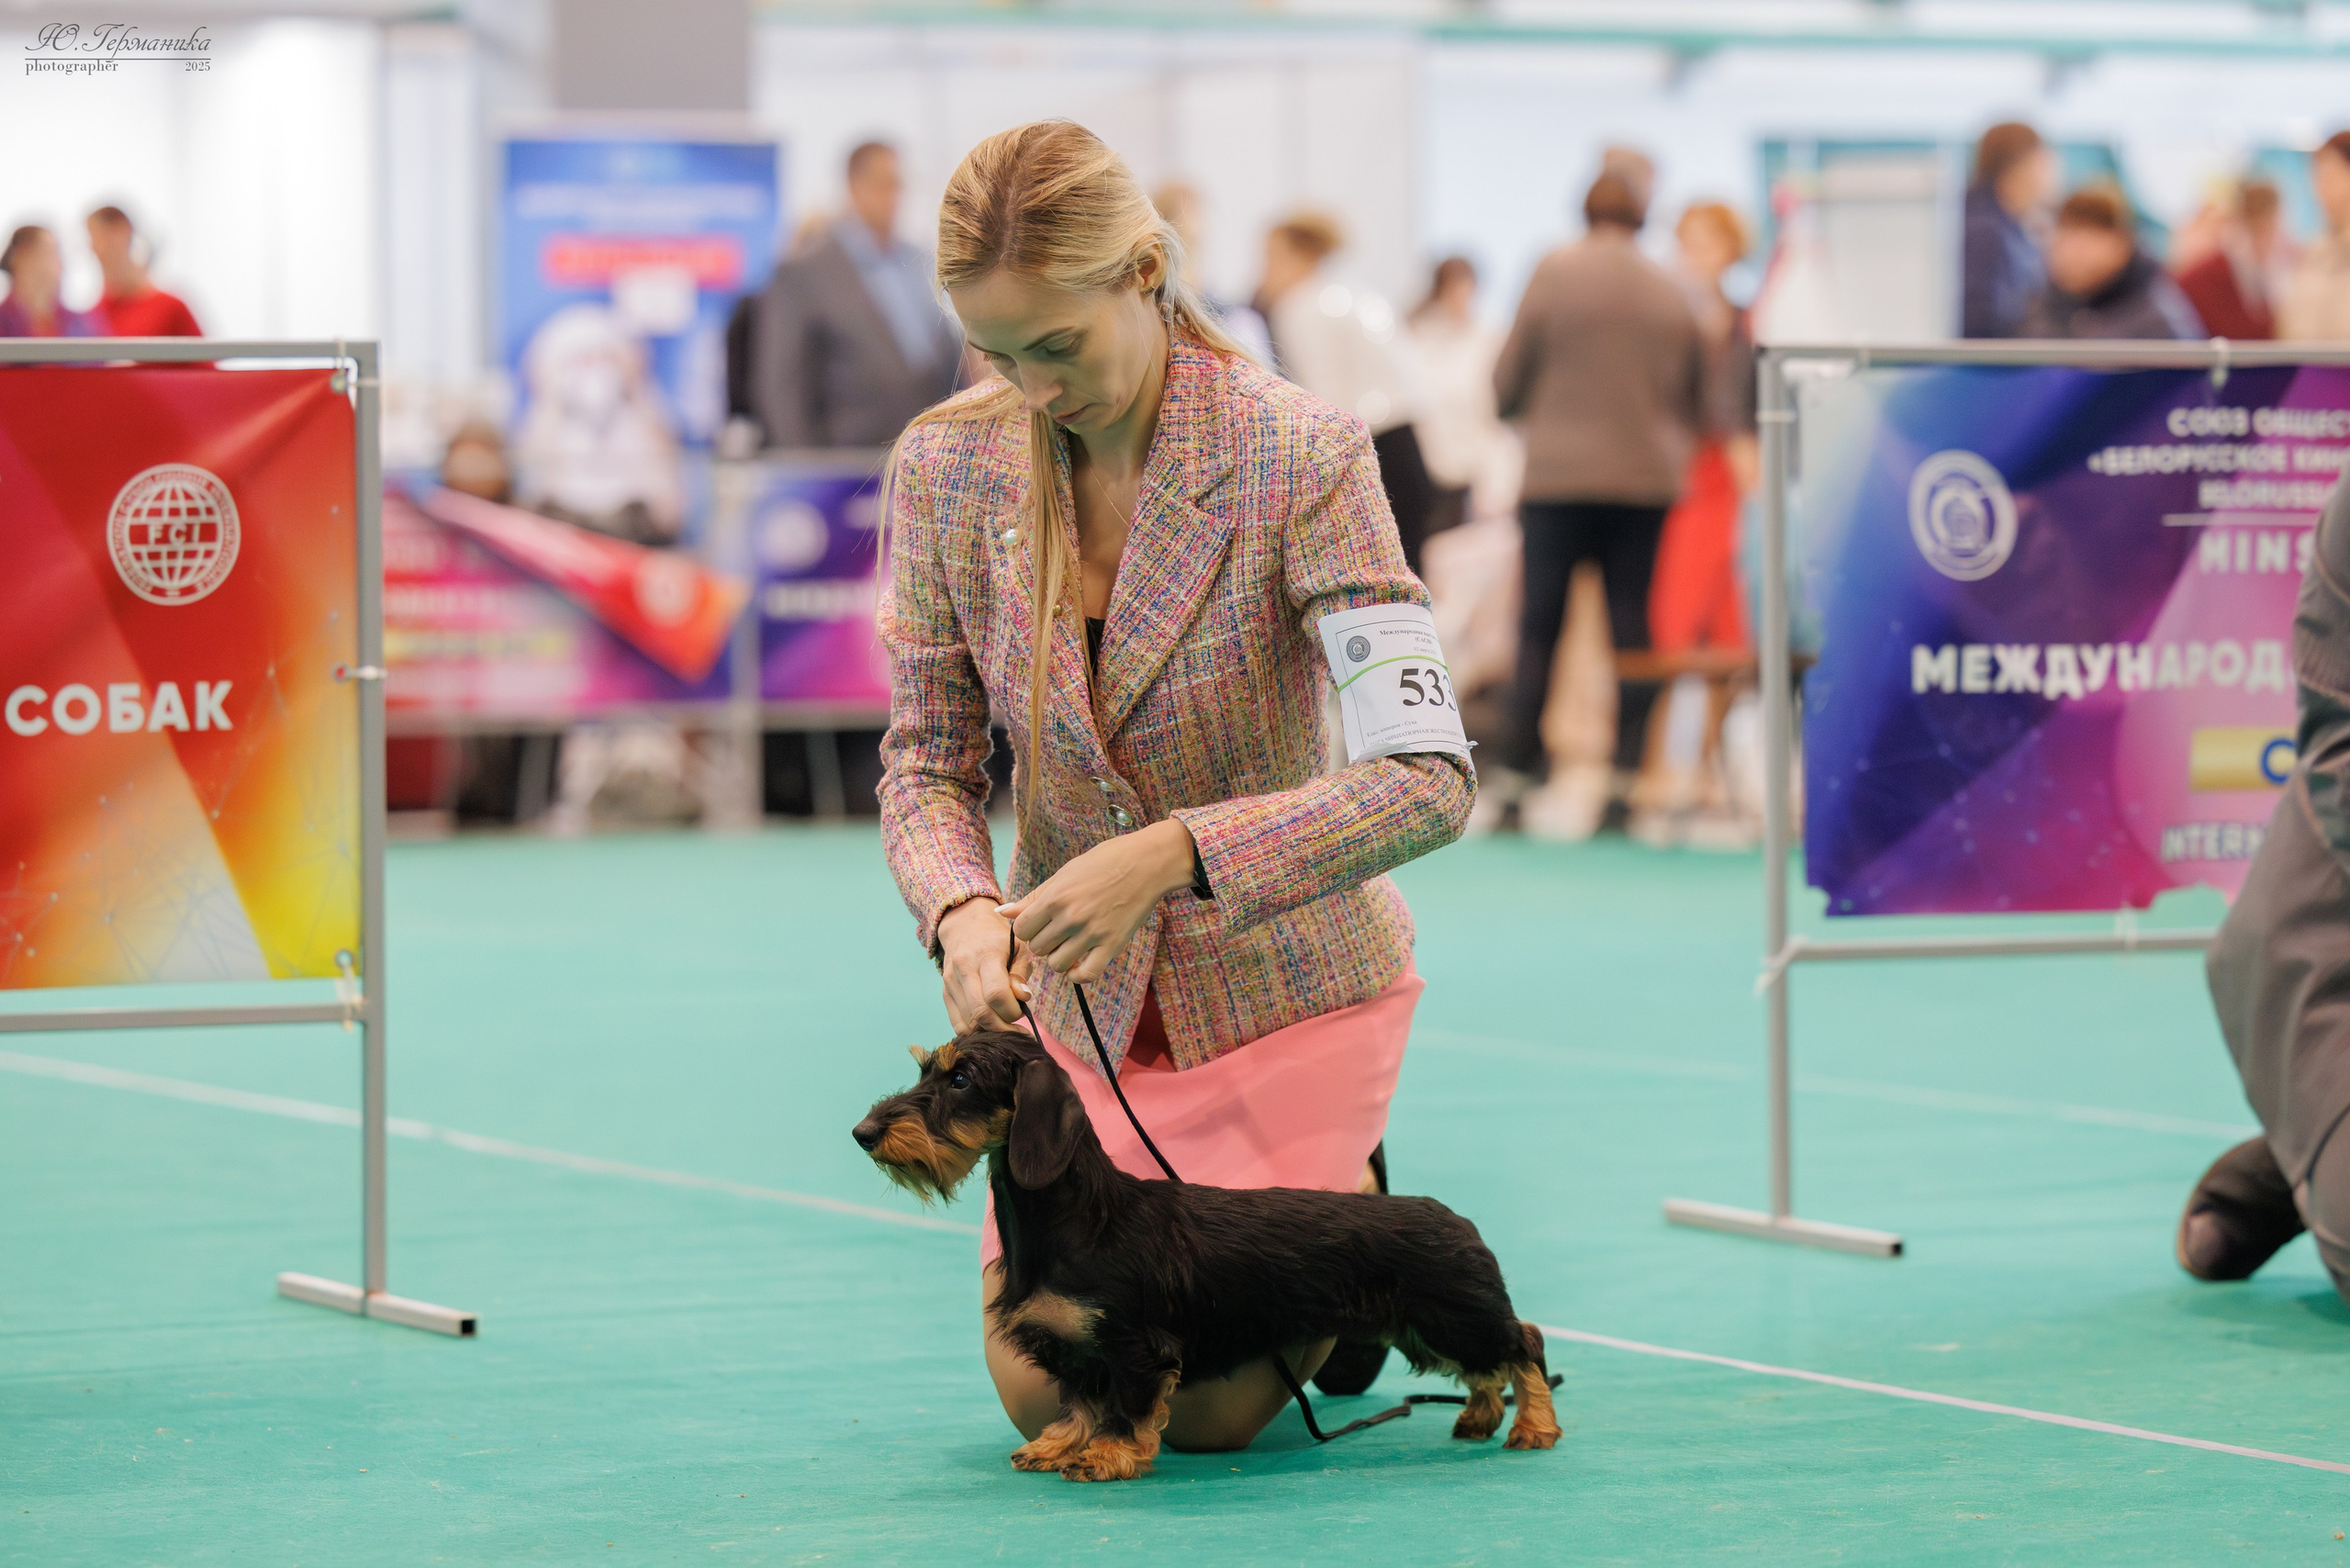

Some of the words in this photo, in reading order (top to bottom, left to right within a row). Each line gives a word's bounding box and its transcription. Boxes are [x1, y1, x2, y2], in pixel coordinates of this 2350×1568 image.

[2167, 408, 2249, 437] СОЮЗ
[148, 521, 200, 546] FCI
[1911, 642, 2297, 701] МЕЖДУНАРОД
[5, 679, 234, 737] СОБАК
